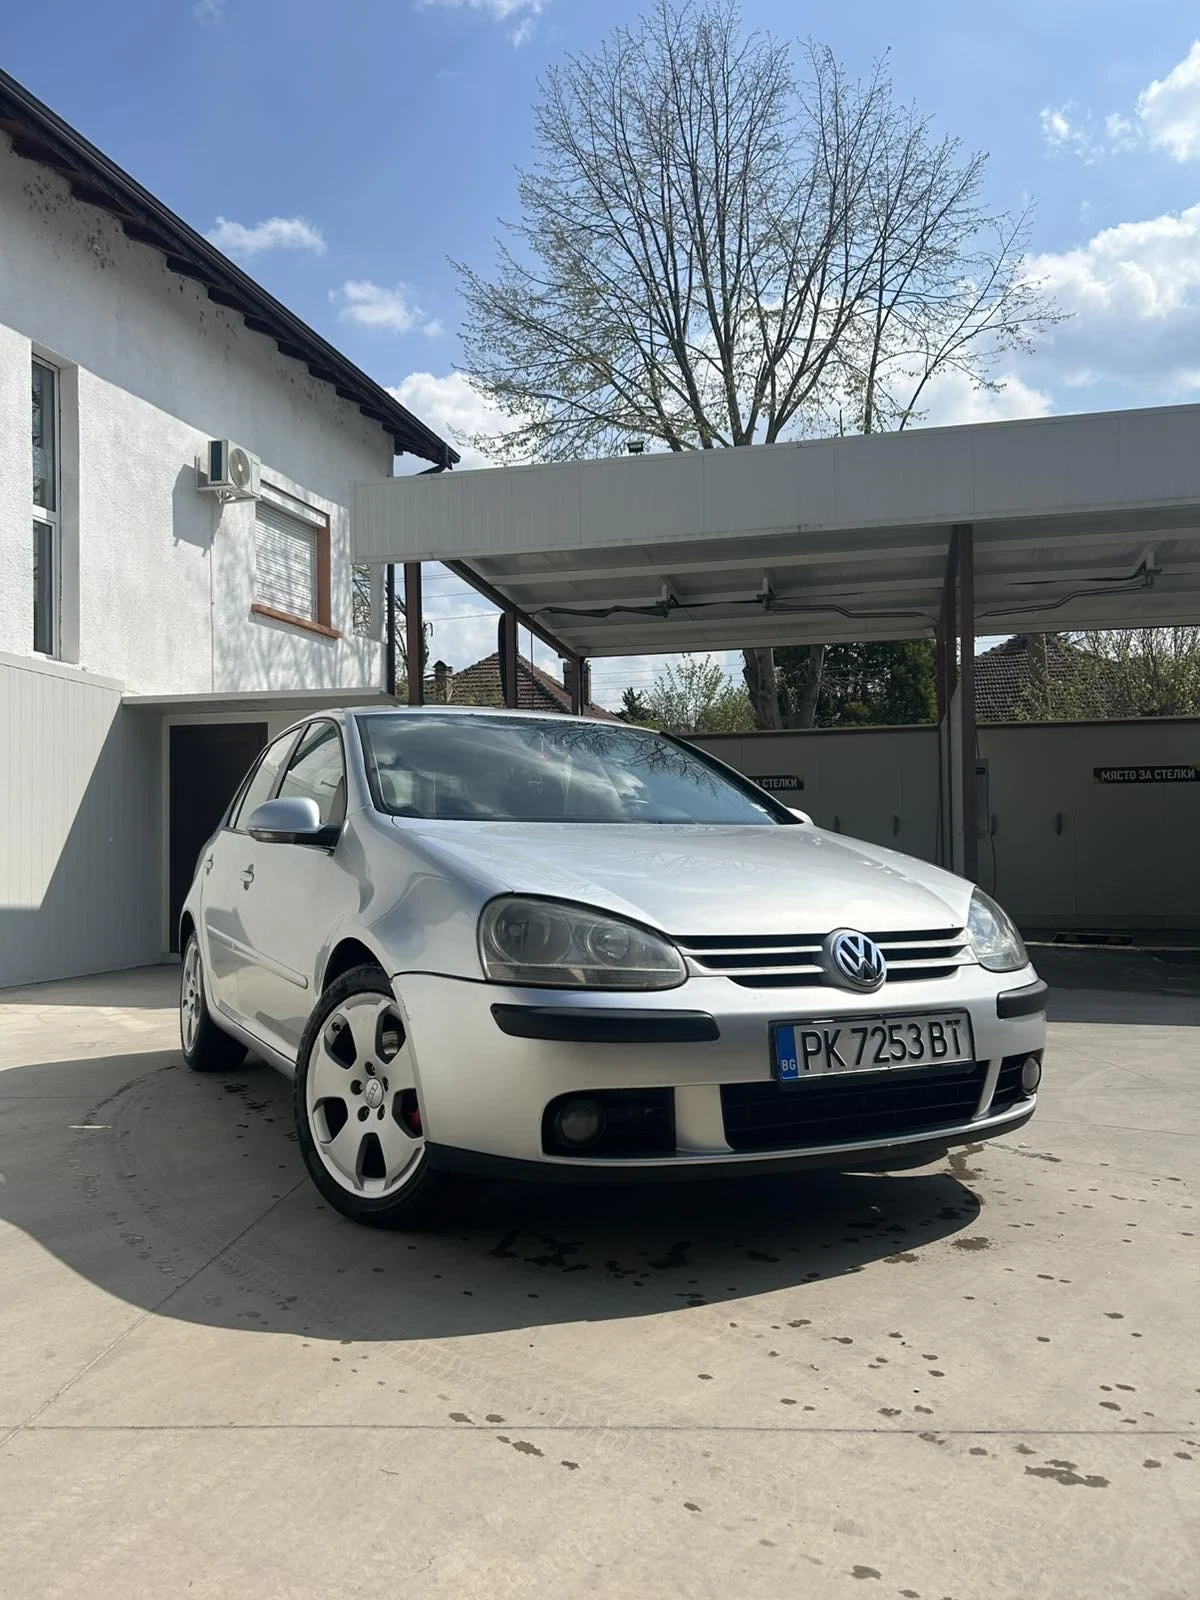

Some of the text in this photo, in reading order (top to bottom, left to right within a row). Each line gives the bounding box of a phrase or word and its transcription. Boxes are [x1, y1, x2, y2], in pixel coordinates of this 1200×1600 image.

[1101, 769, 1195, 781] МЯСТО ЗА СТЕЛКИ
[762, 778, 797, 788] СТЕЛКИ
[801, 1019, 962, 1070] PK 7253 BT
[781, 1059, 796, 1071] BG
